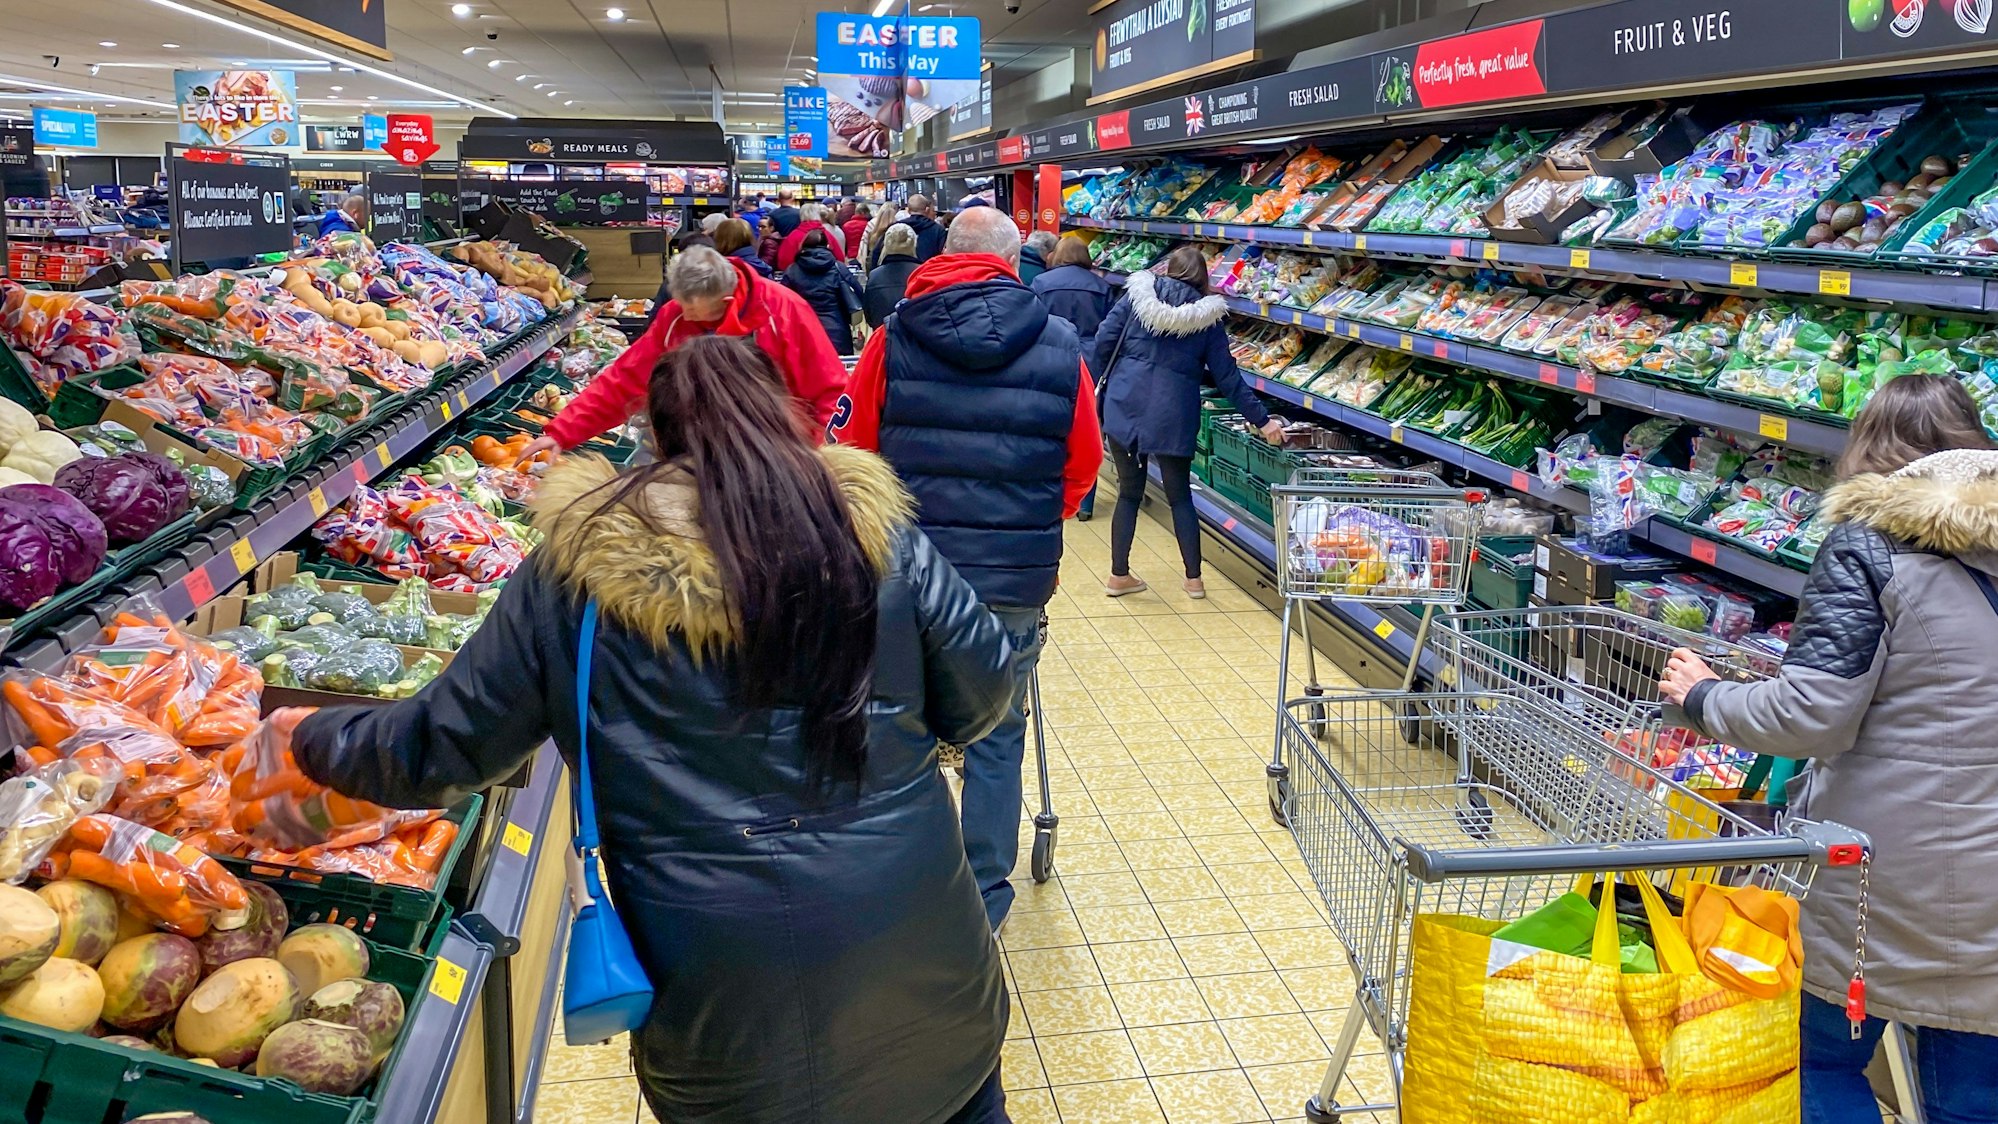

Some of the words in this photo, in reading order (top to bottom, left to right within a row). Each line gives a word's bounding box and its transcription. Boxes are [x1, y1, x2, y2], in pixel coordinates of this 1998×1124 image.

[1109, 8, 1146, 47] FFRWYTHAU
[1147, 5, 1153, 32] A
[1154, 0, 1183, 29] LLYSIAU
[1216, 15, 1228, 31] EVERY
[1229, 8, 1252, 27] FORTNIGHT
[838, 22, 958, 48] EASTER
[1614, 22, 1665, 54] FRUIT
[1672, 19, 1685, 46] &
[1692, 11, 1731, 42] VEG
[858, 52, 896, 69] This
[1109, 51, 1120, 69] FRUIT
[1124, 47, 1132, 64] VEG
[1419, 61, 1453, 85] Perfectly
[1454, 56, 1477, 82] fresh,
[1479, 53, 1503, 79] great
[1504, 47, 1529, 71] value
[788, 97, 824, 109] LIKE
[1219, 92, 1247, 109] CHAMPIONING
[1289, 88, 1312, 107] FRESH
[1314, 83, 1339, 103] SALAD
[182, 102, 295, 122] EASTER
[1211, 115, 1223, 127] GREAT
[1224, 111, 1239, 125] BRITISH
[1240, 108, 1258, 124] QUALITY
[392, 127, 422, 135] amazing
[1144, 119, 1156, 131] FRESH
[1157, 115, 1170, 129] SALAD
[401, 135, 428, 143] savings
[563, 144, 594, 152] READY
[597, 145, 628, 153] MEALS
[790, 138, 809, 146] £3.69
[182, 181, 190, 199] All
[191, 180, 197, 201] of
[197, 187, 205, 199] our
[205, 180, 226, 199] bananas
[227, 188, 235, 199] are
[520, 188, 531, 196] Add
[544, 188, 558, 197] final
[184, 210, 204, 229] Alliance
[205, 209, 224, 230] Certified
[225, 216, 230, 227] or
